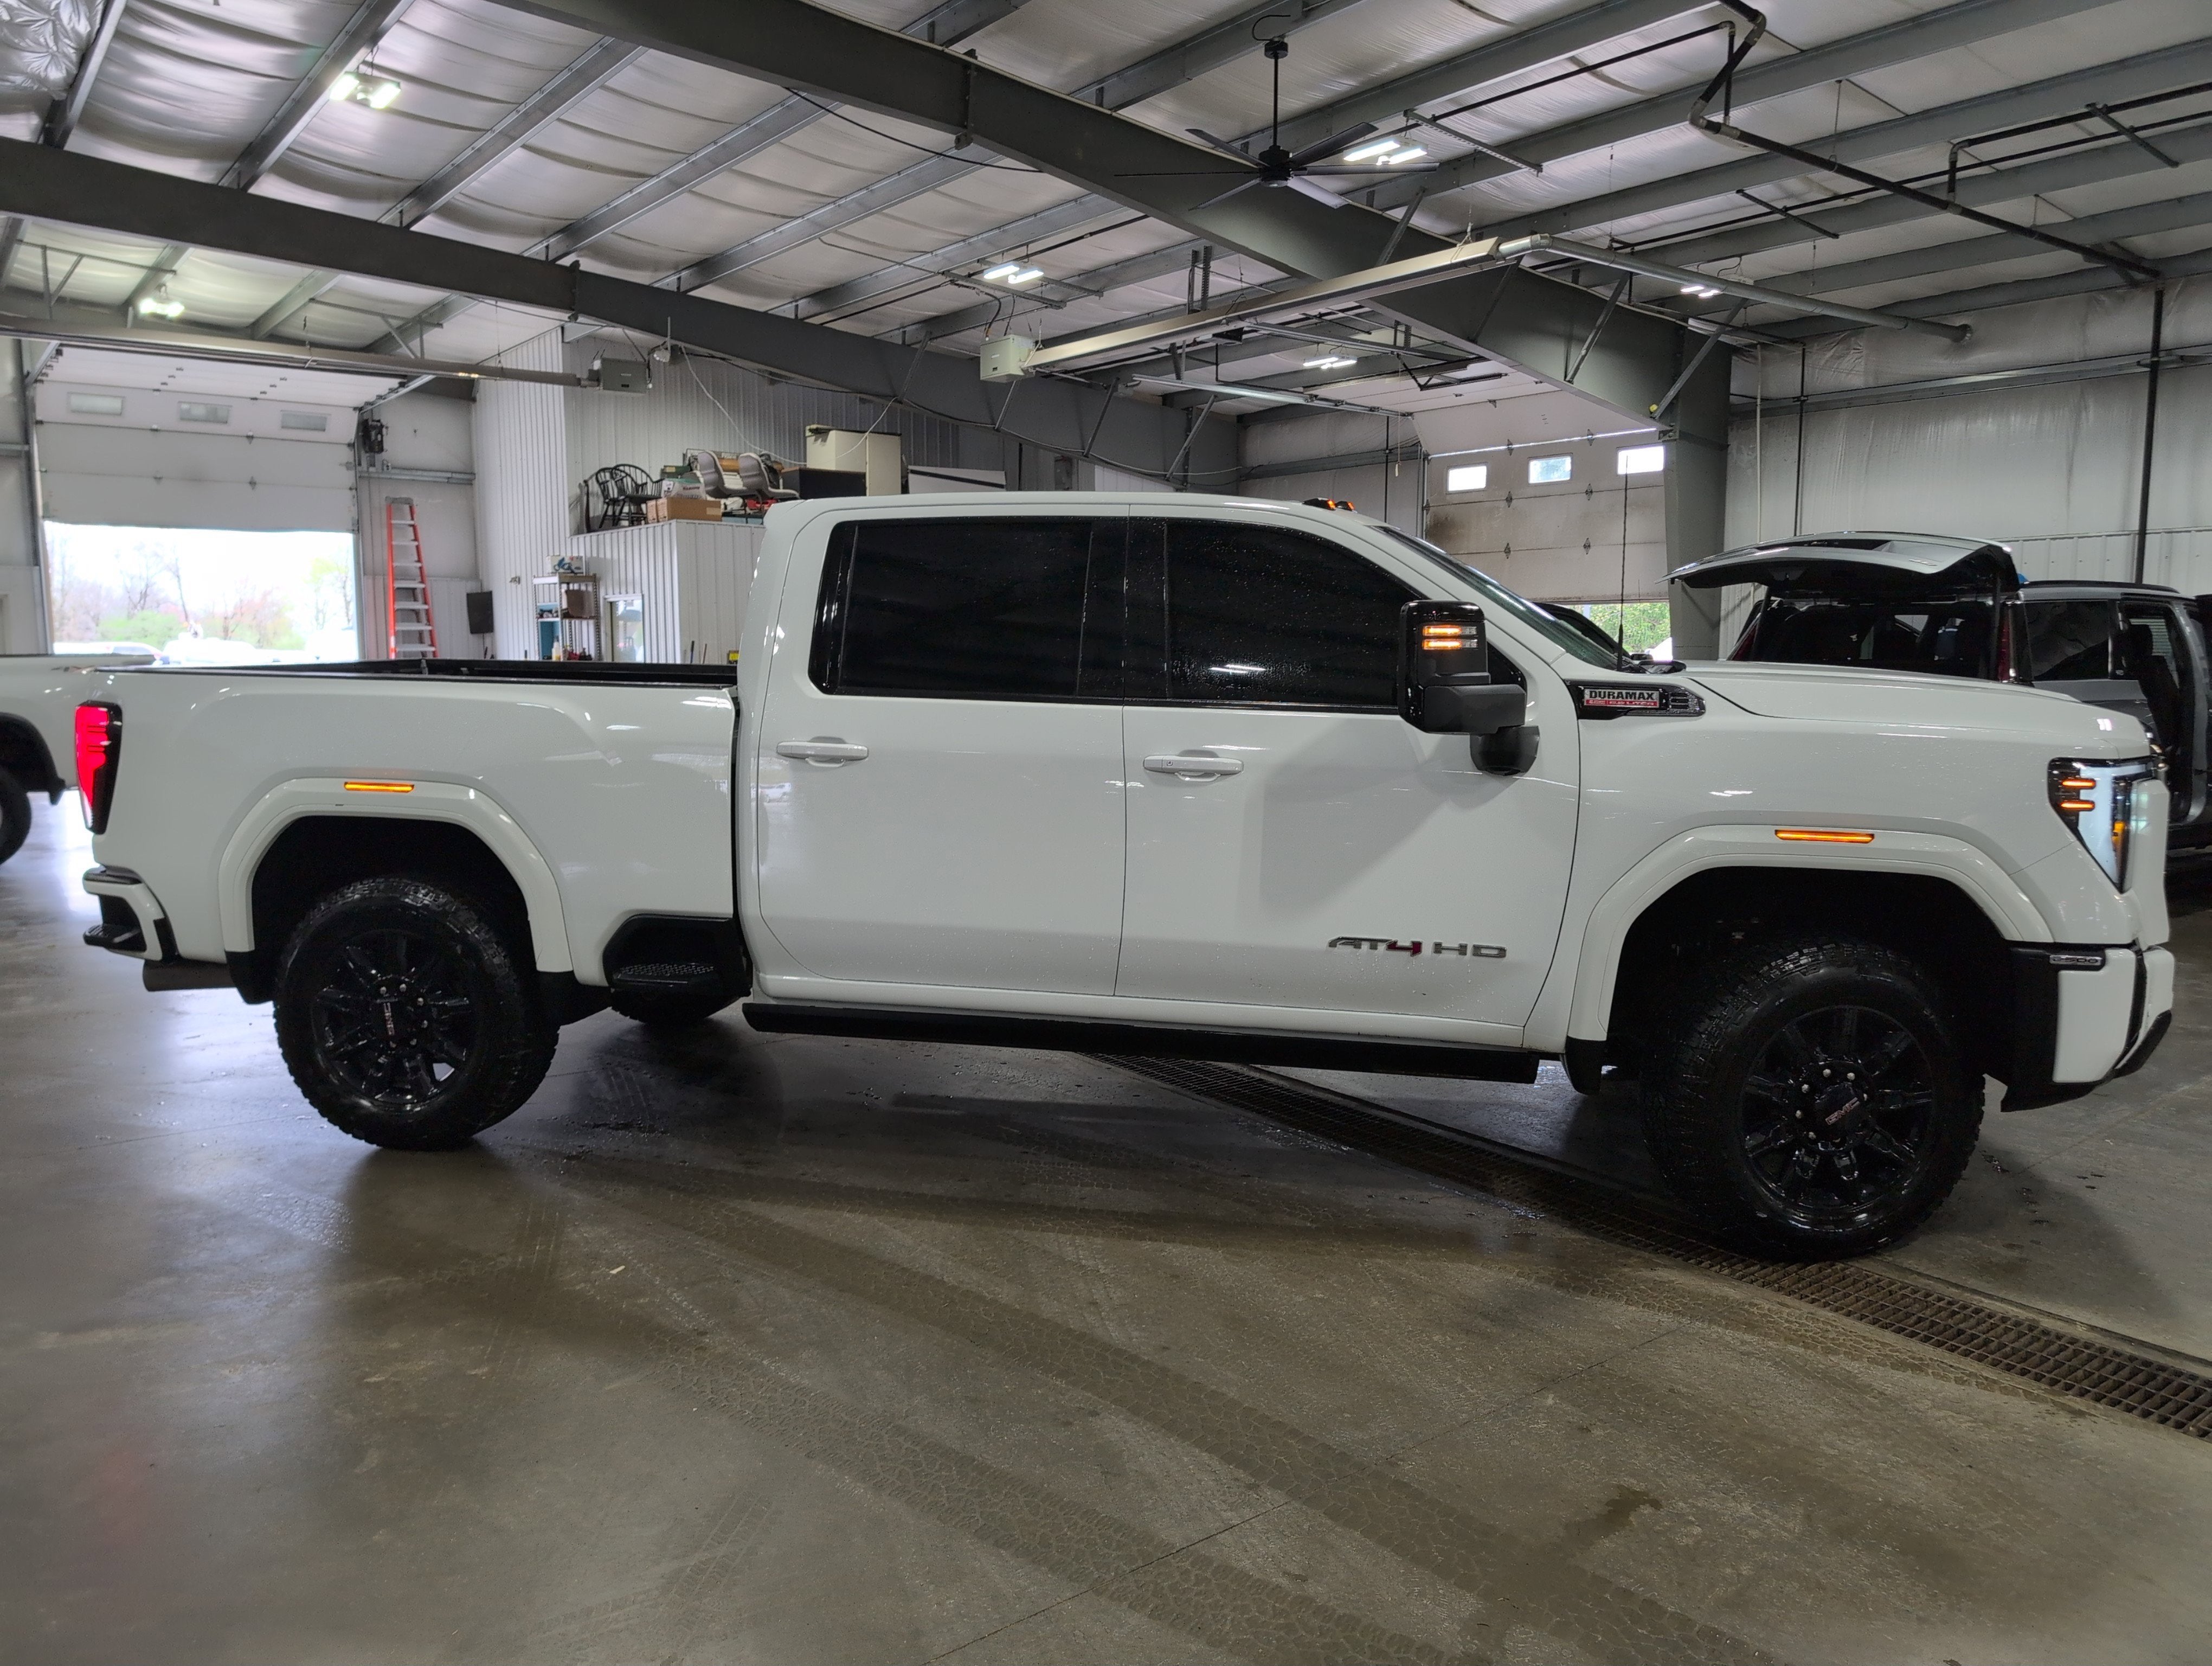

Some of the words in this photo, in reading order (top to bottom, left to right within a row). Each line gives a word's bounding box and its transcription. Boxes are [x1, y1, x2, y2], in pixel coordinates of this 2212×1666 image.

[1589, 690, 1655, 700] DURAMAX
[1328, 936, 1422, 957] AT4
[1433, 941, 1507, 958] HD
[1825, 1097, 1860, 1125] GMC
